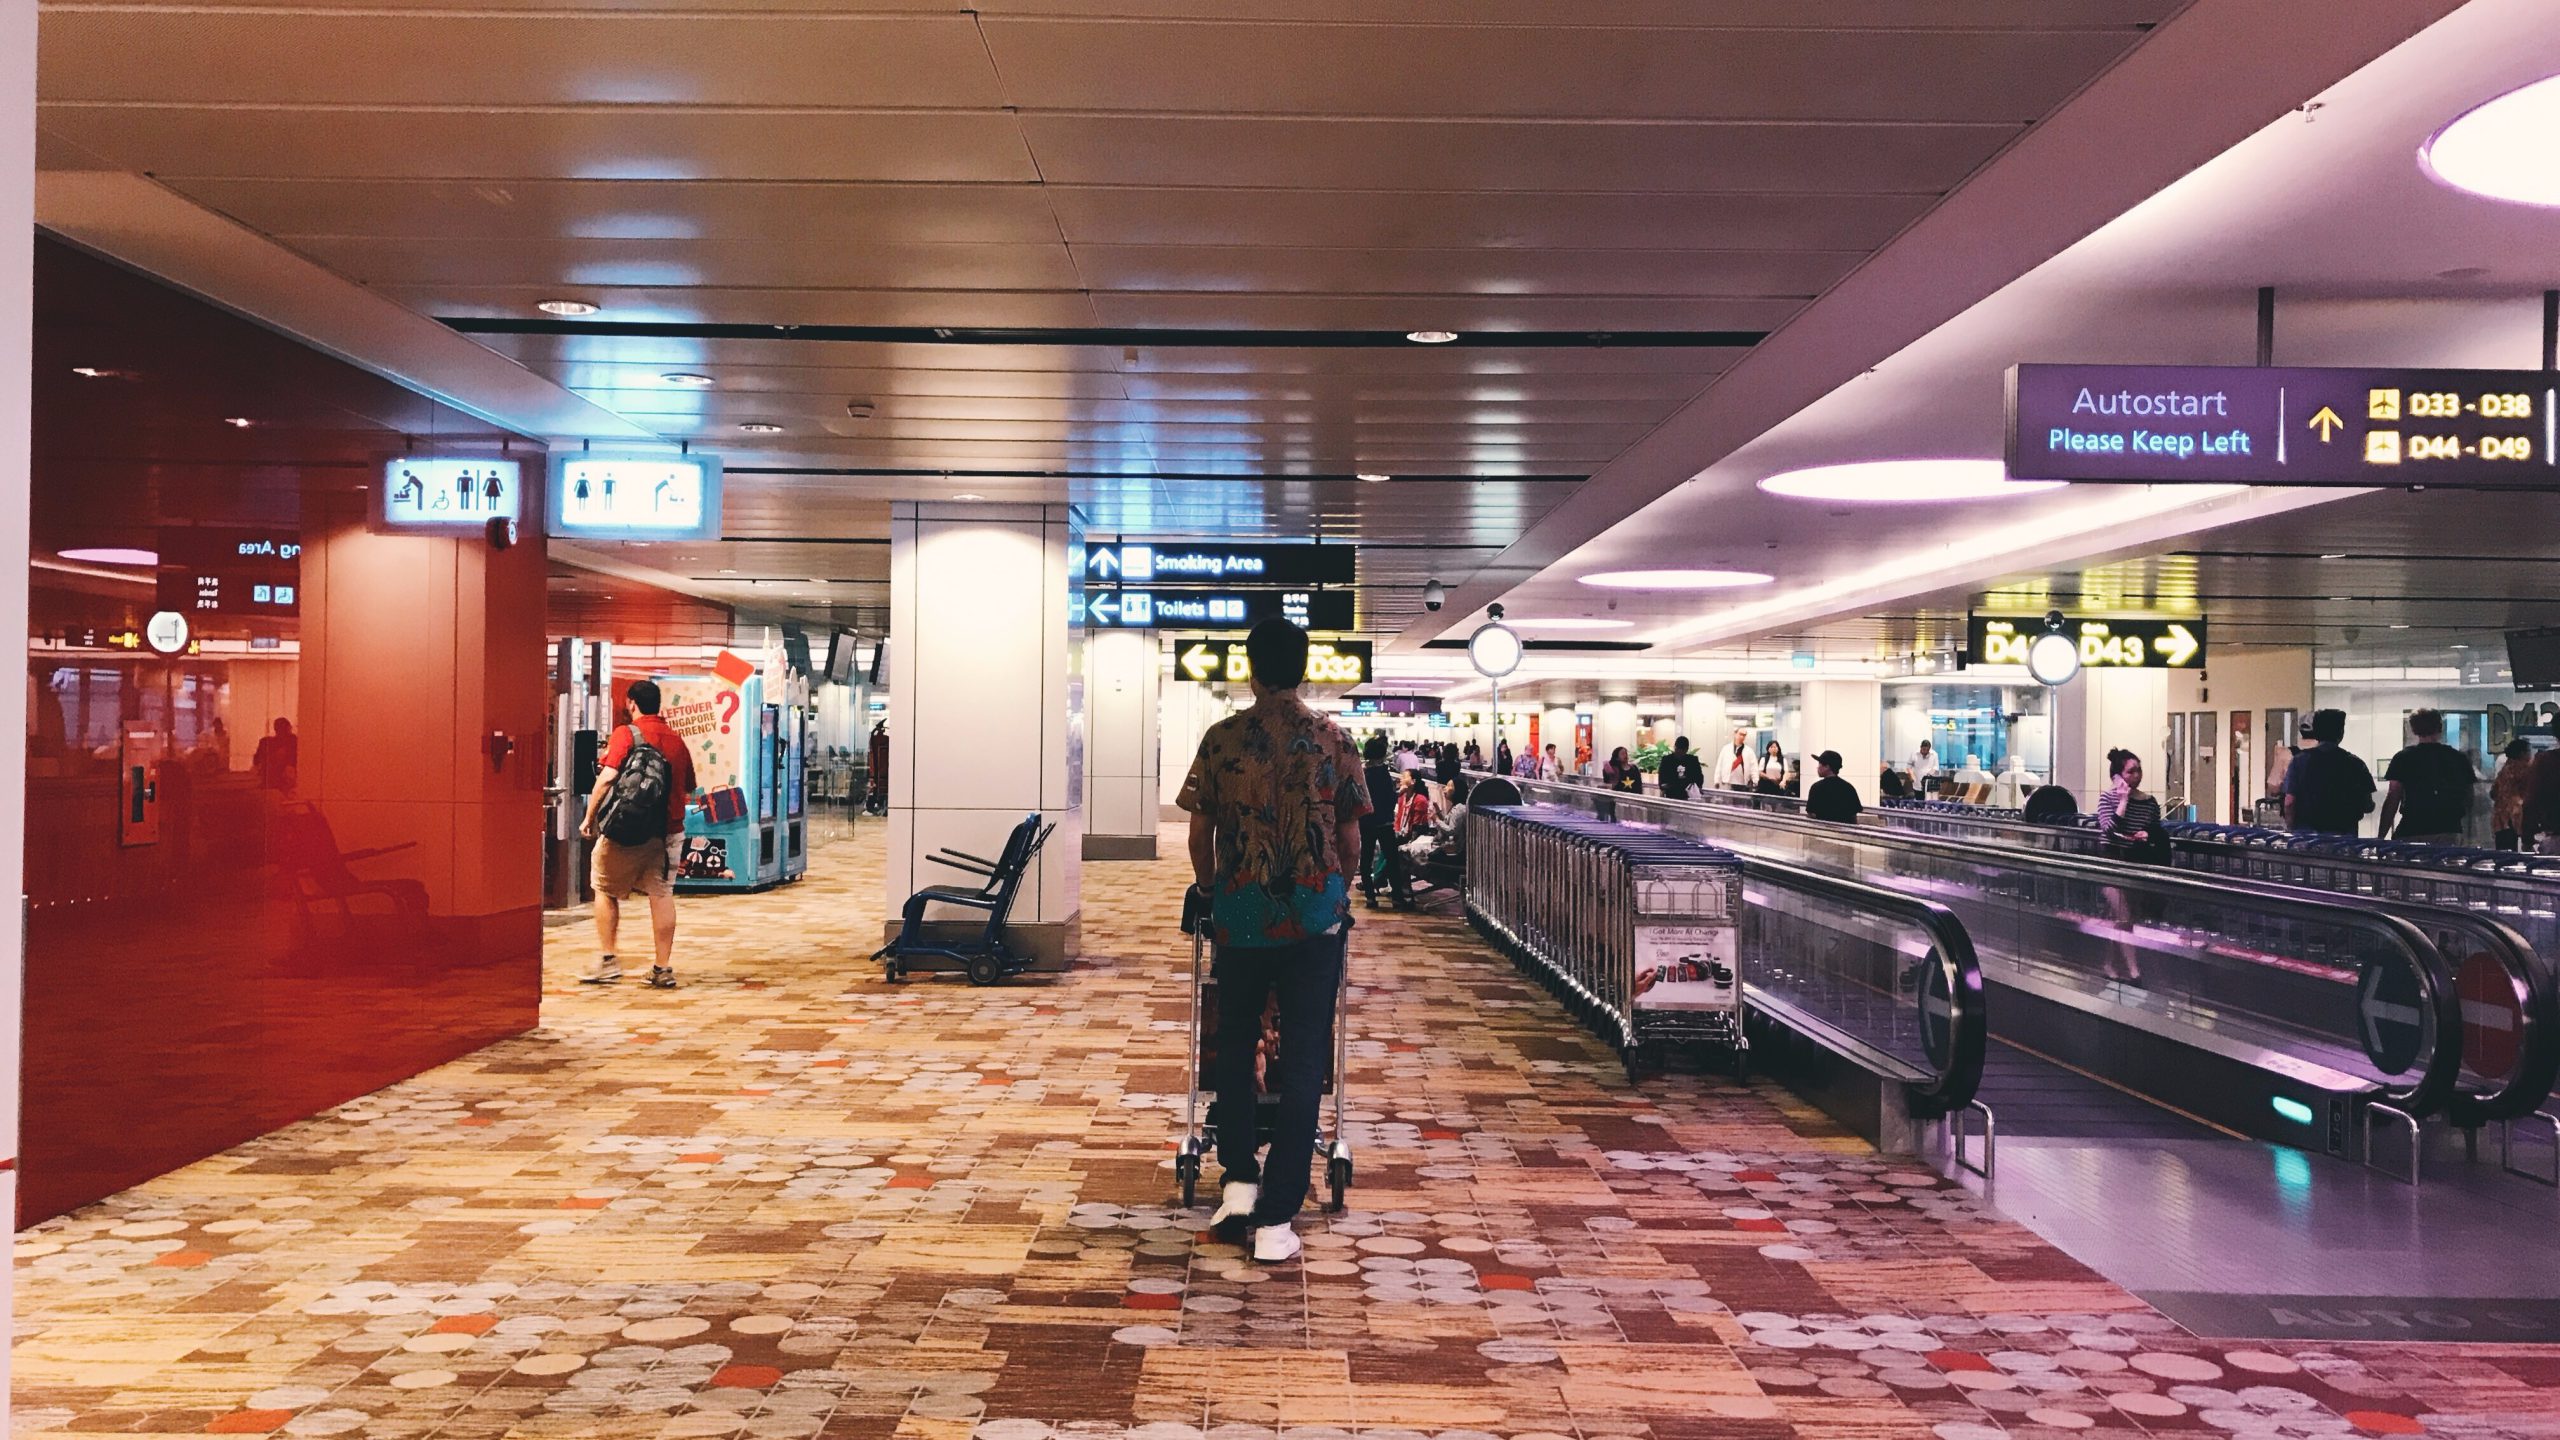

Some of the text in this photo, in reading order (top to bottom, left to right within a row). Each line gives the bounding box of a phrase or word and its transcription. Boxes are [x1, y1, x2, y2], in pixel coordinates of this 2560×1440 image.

[2072, 387, 2228, 417] Autostart
[2409, 392, 2461, 417] D33
[2480, 393, 2532, 418] D38
[2049, 429, 2251, 456] Please Keep Left
[2408, 435, 2461, 460] D44
[2480, 436, 2532, 461] D49
[1155, 555, 1263, 575] Smoking Area
[1156, 601, 1206, 617] Toilets
[1985, 634, 2037, 663] D4
[2080, 635, 2144, 665] D43
[1308, 655, 1362, 682] D32
[660, 702, 712, 719] LEFTOVER
[668, 712, 716, 729] INGAPORE
